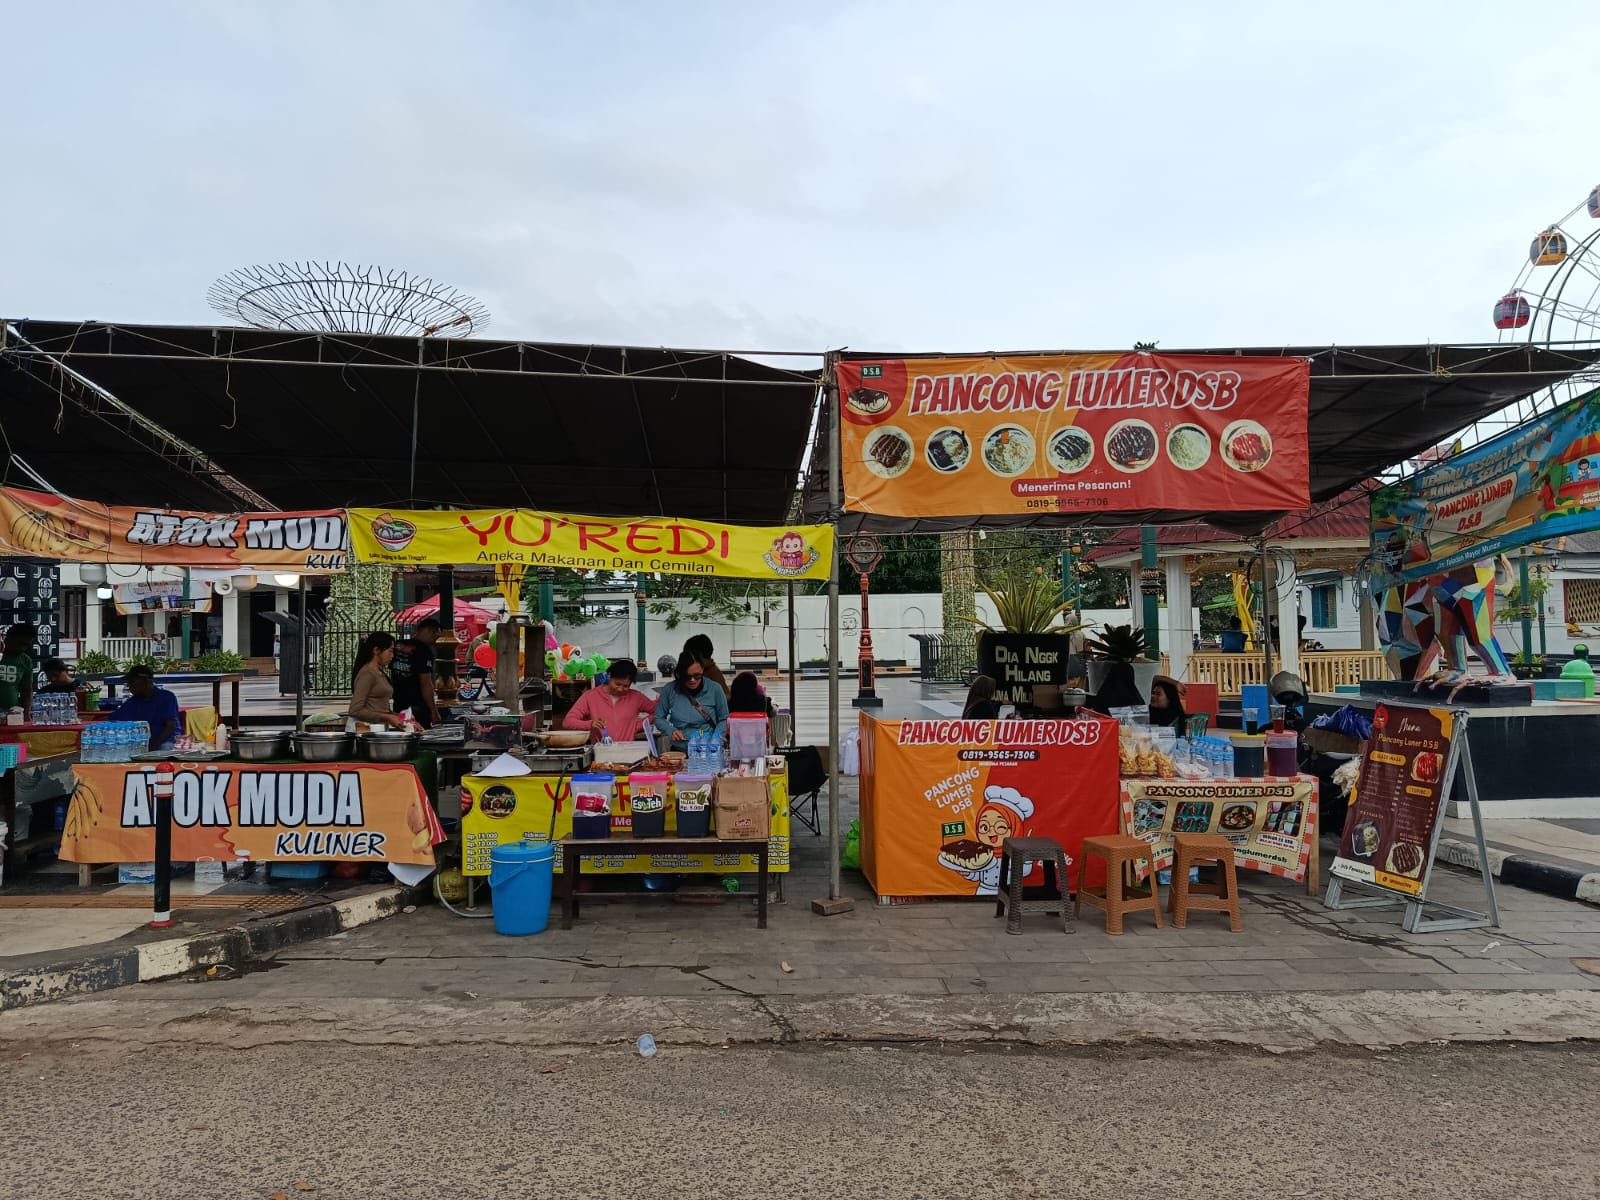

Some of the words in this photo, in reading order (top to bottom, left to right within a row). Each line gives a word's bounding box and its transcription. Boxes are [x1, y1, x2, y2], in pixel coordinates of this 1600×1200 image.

[908, 371, 1066, 416] PANCONG
[1064, 367, 1170, 412] LUMER
[1171, 369, 1242, 411] DSB
[1018, 481, 1075, 493] Menerima
[1078, 479, 1132, 491] Pesanan!
[1436, 492, 1480, 521] PANCONG
[1481, 479, 1513, 505] LUMER
[126, 512, 240, 549] ATOK
[459, 514, 730, 559] YU'REDI
[476, 550, 526, 563] Aneka
[530, 551, 607, 568] Makanan
[611, 557, 645, 570] Dan
[649, 557, 716, 574] Cemilan
[898, 719, 990, 745] PANCONG
[992, 719, 1058, 745] LUMER
[1057, 719, 1101, 745] DSB
[962, 750, 1036, 760] 0819-9565-7306
[923, 766, 981, 802] PANCONG
[935, 783, 975, 809] LUMER
[1146, 786, 1215, 798] PANCONG
[1215, 786, 1263, 798] LUMER
[1265, 786, 1294, 798] DSB
[239, 771, 364, 828] MUDA
[951, 797, 973, 815] DSB
[275, 831, 386, 858] KULINER
